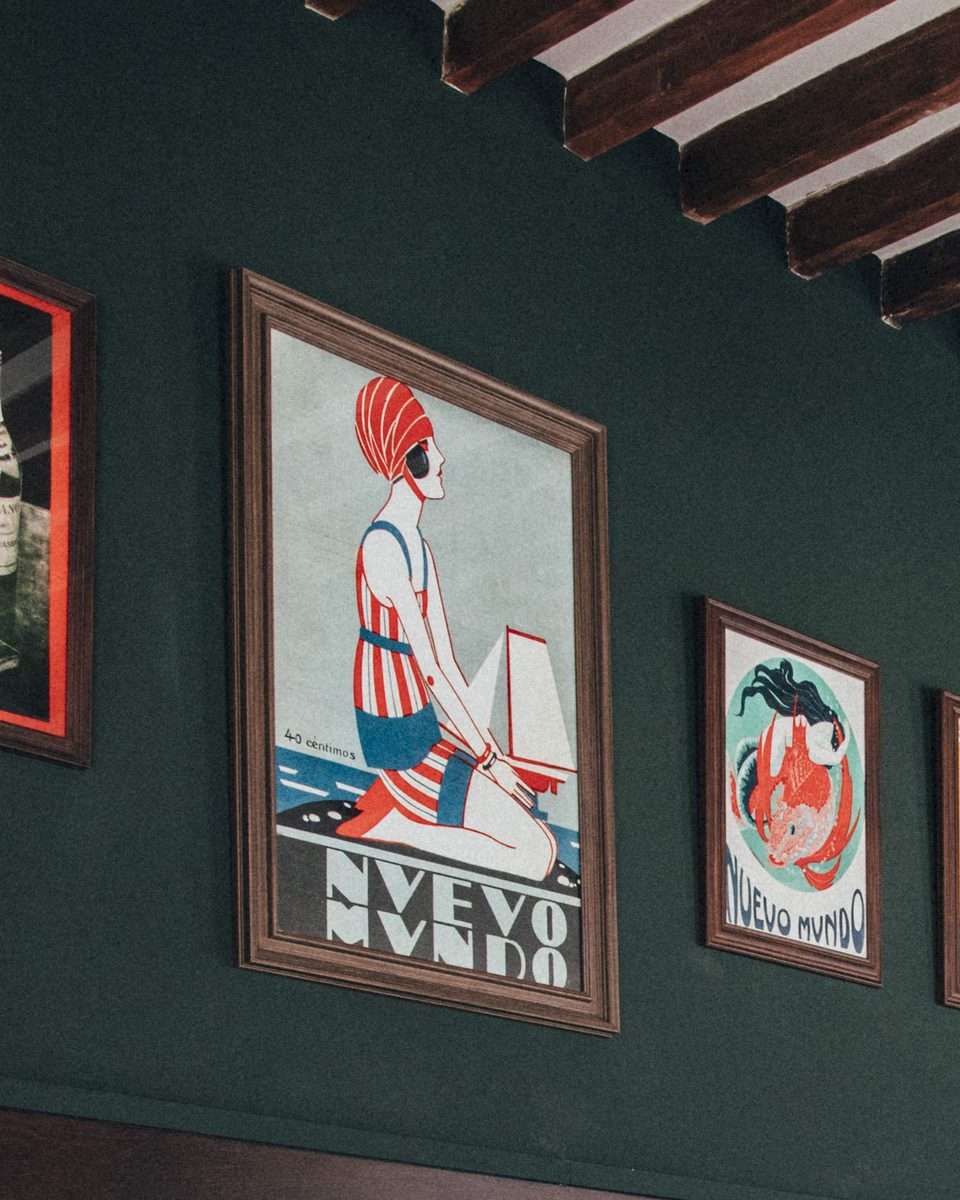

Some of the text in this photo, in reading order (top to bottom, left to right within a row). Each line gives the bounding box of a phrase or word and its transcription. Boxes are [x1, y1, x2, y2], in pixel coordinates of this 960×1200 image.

[284, 729, 302, 744] 40
[726, 842, 865, 954] NUEVO MUNDO
